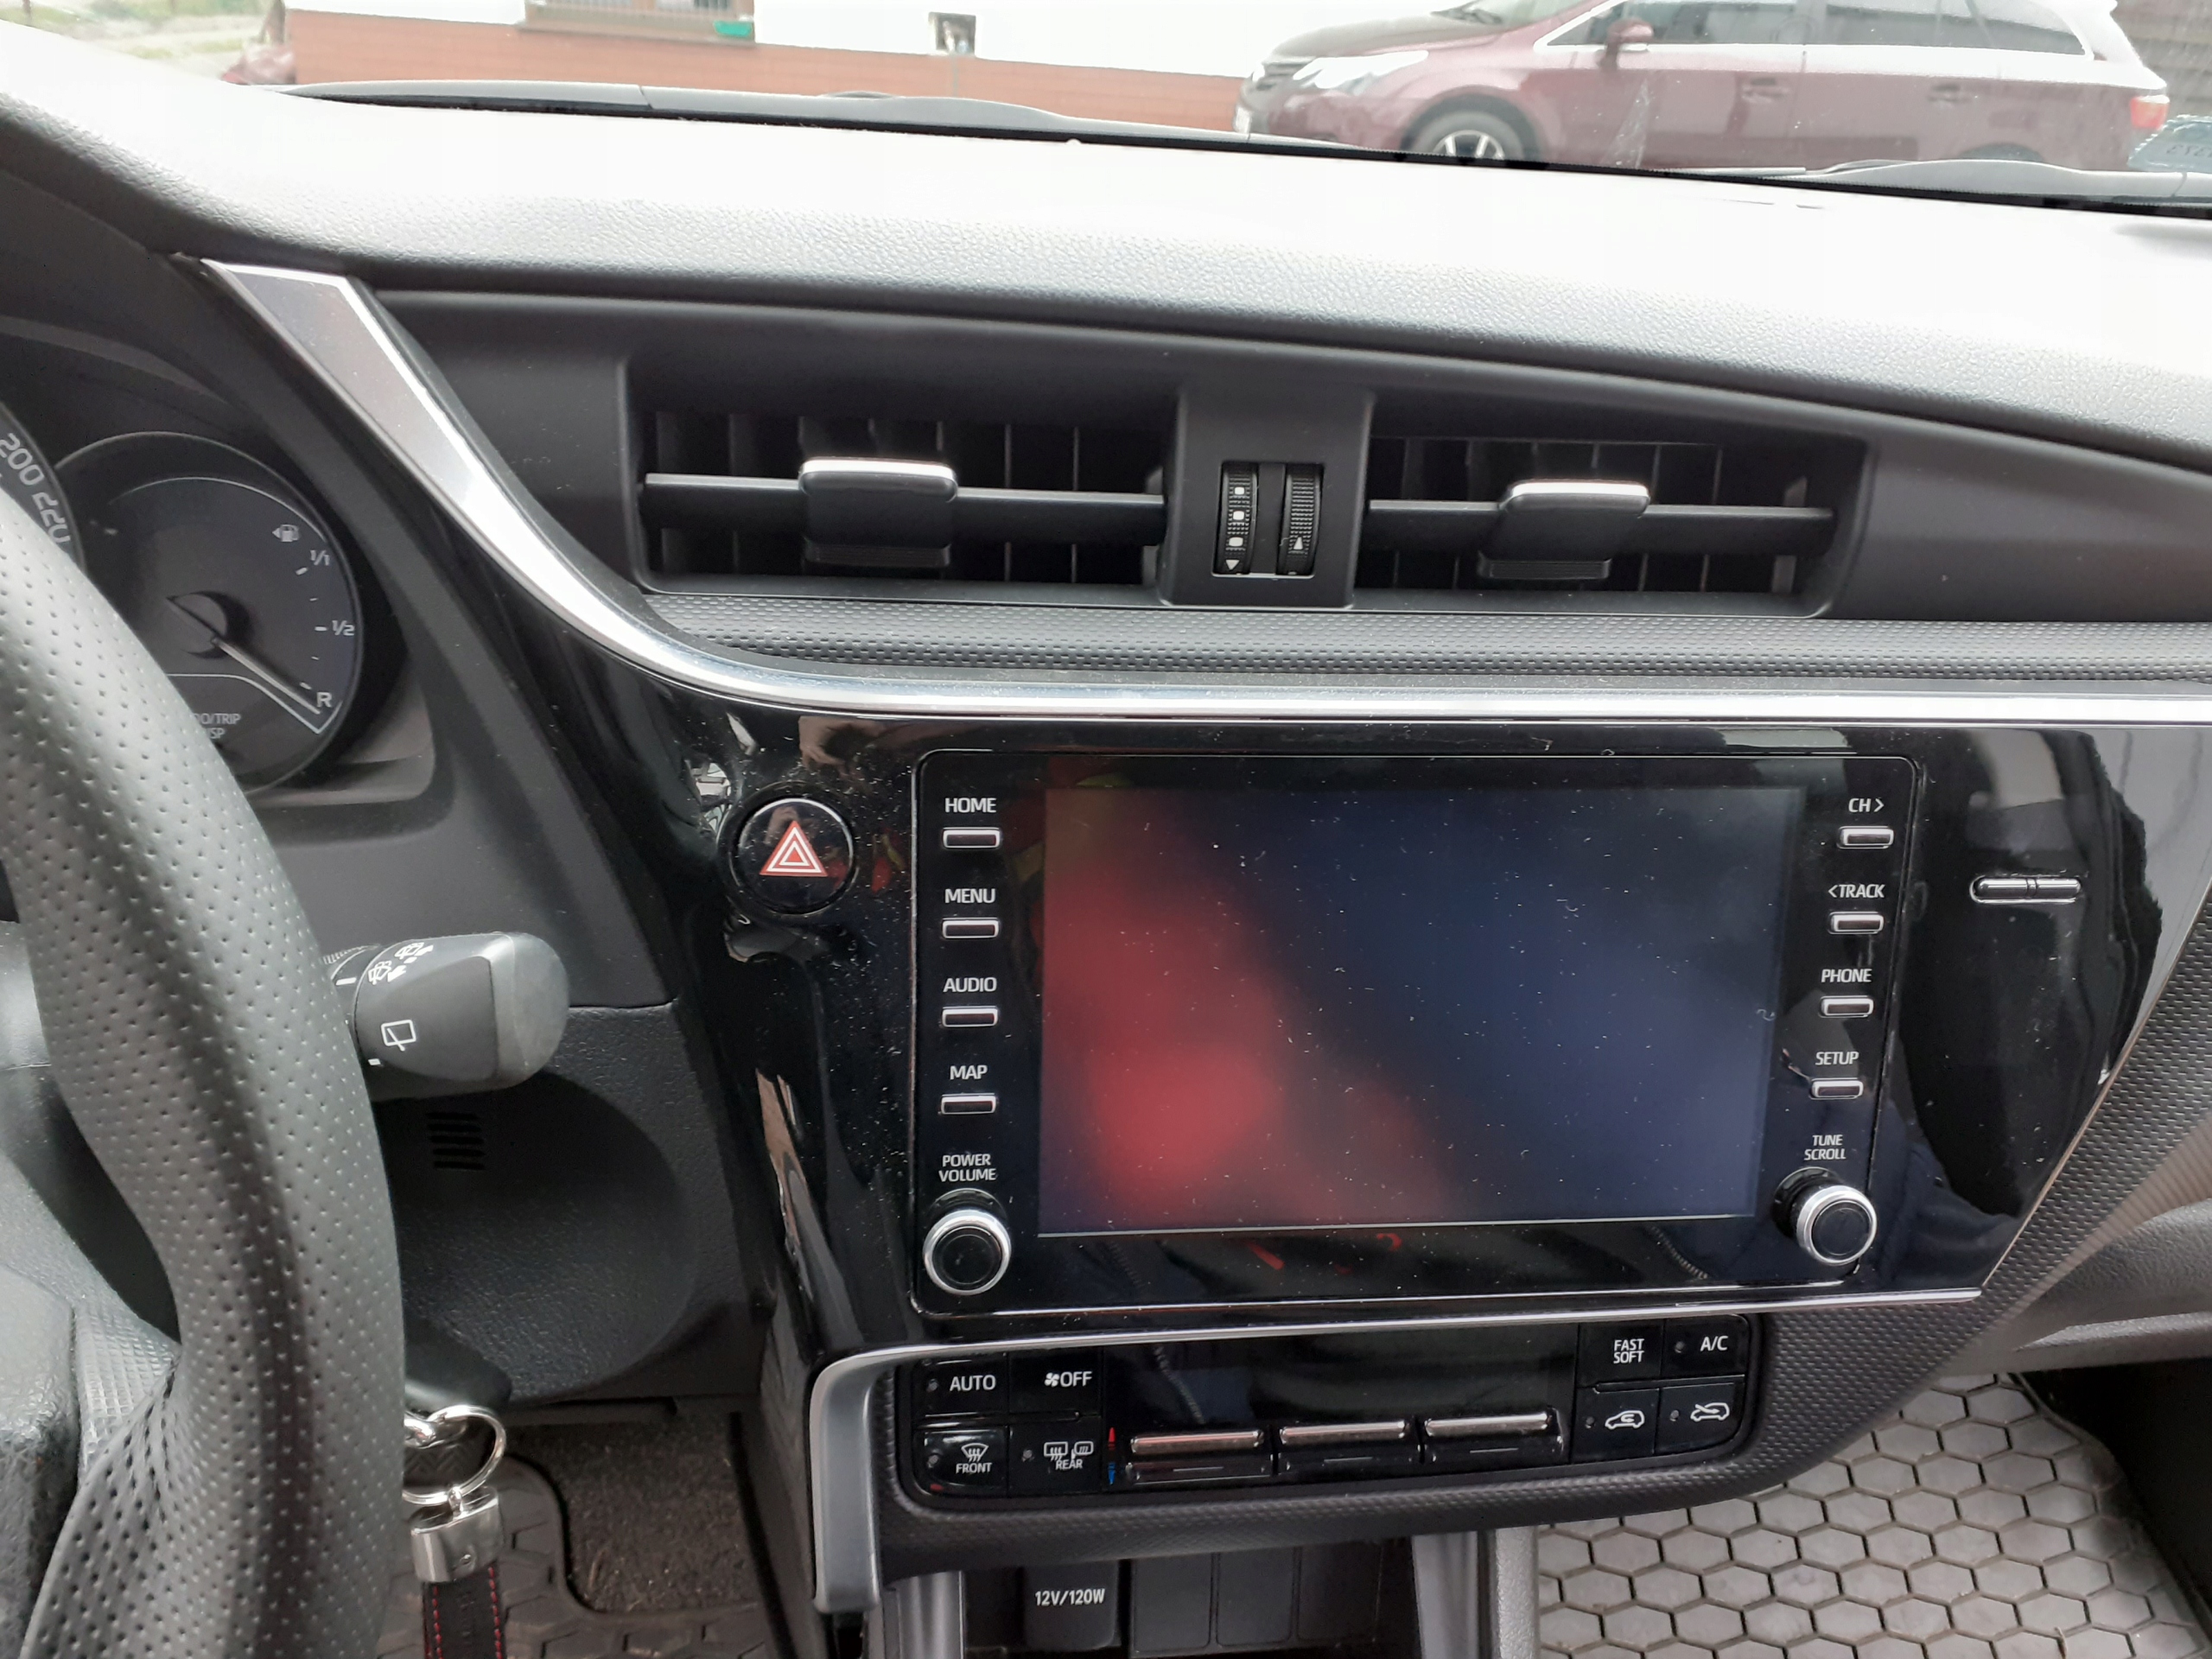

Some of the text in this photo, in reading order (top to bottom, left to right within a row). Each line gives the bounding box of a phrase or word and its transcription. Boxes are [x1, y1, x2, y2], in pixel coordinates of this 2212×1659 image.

[0, 432, 45, 486] 200
[332, 620, 355, 636] 1/2
[316, 692, 333, 708] R
[944, 797, 997, 813] HOME
[944, 888, 996, 904] MENU
[1821, 968, 1872, 983] PHONE
[943, 976, 997, 993] AUDIO
[1815, 1051, 1859, 1065] SETUP
[950, 1065, 988, 1080] MAP
[1812, 1134, 1843, 1147] TUNE
[942, 1154, 991, 1168] POWER
[1804, 1147, 1847, 1160] SCROLL
[938, 1168, 996, 1182] VOLUME
[1613, 1338, 1644, 1351] FAST
[1700, 1335, 1728, 1351] A/C
[1613, 1350, 1644, 1364] SOFT
[949, 1374, 996, 1392] AUTO
[1059, 1370, 1092, 1387] OFF
[956, 1462, 993, 1474] FRONT
[1055, 1459, 1084, 1471] REAR
[1035, 1588, 1106, 1606] 12V/120W
